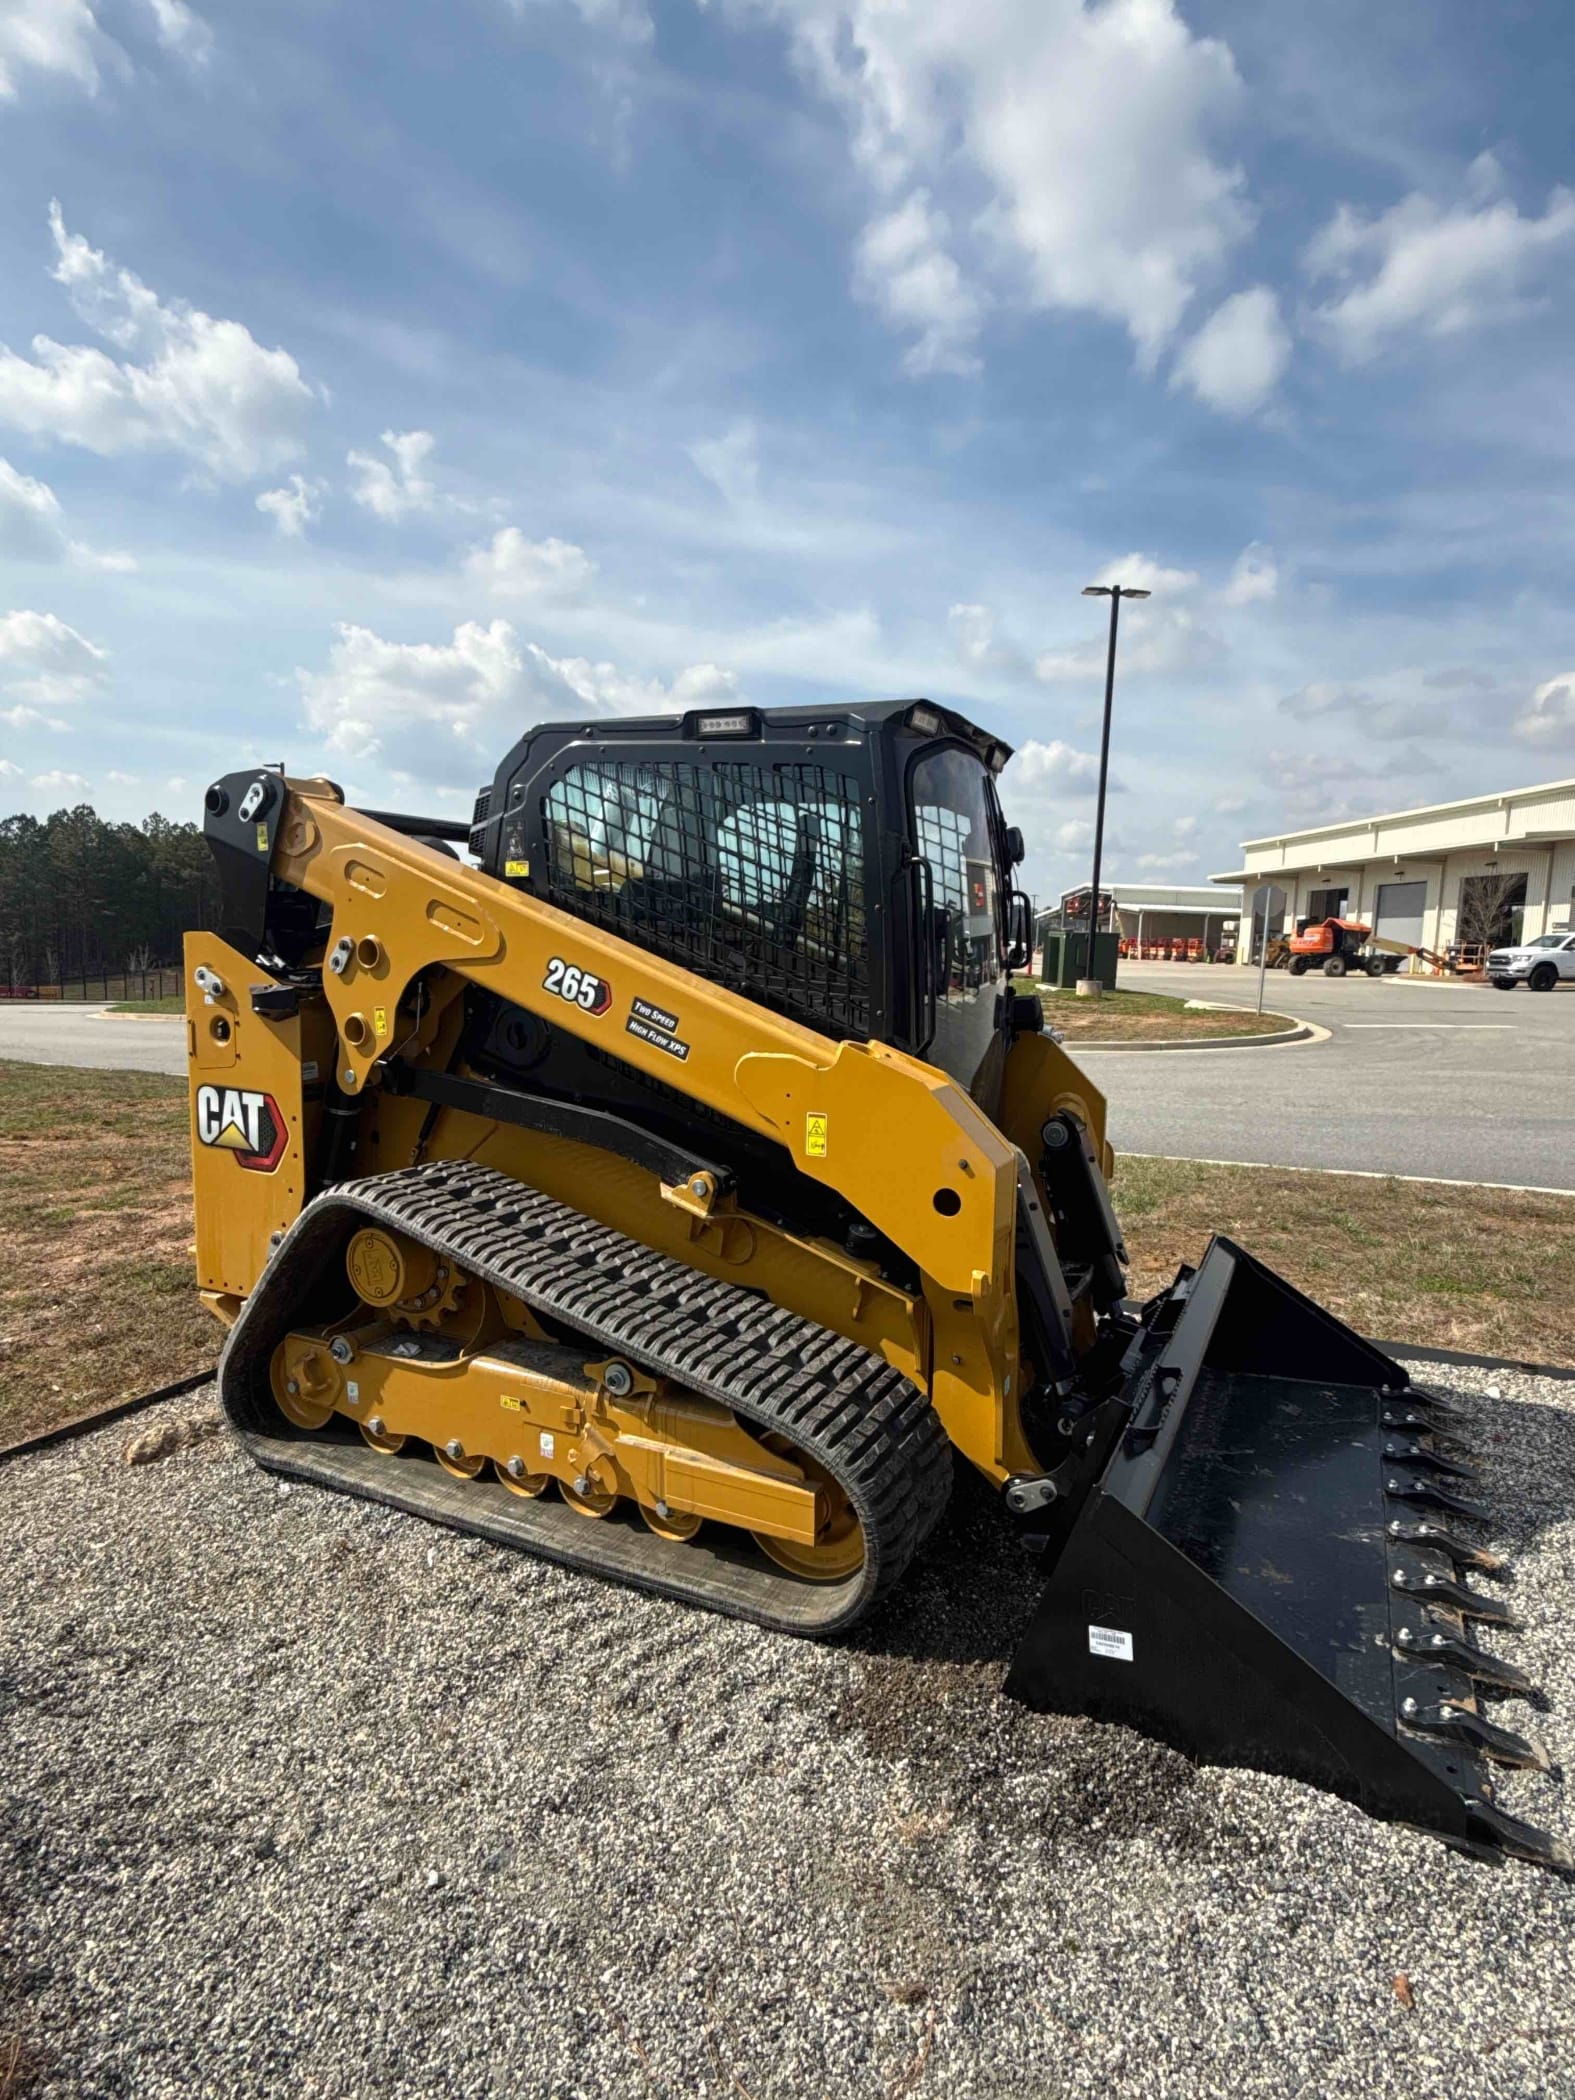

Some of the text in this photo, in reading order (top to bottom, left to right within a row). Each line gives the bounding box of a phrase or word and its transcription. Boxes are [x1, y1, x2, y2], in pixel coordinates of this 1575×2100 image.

[543, 958, 599, 1009] 265
[667, 1040, 687, 1056] XPS
[197, 1085, 265, 1153] CAT
